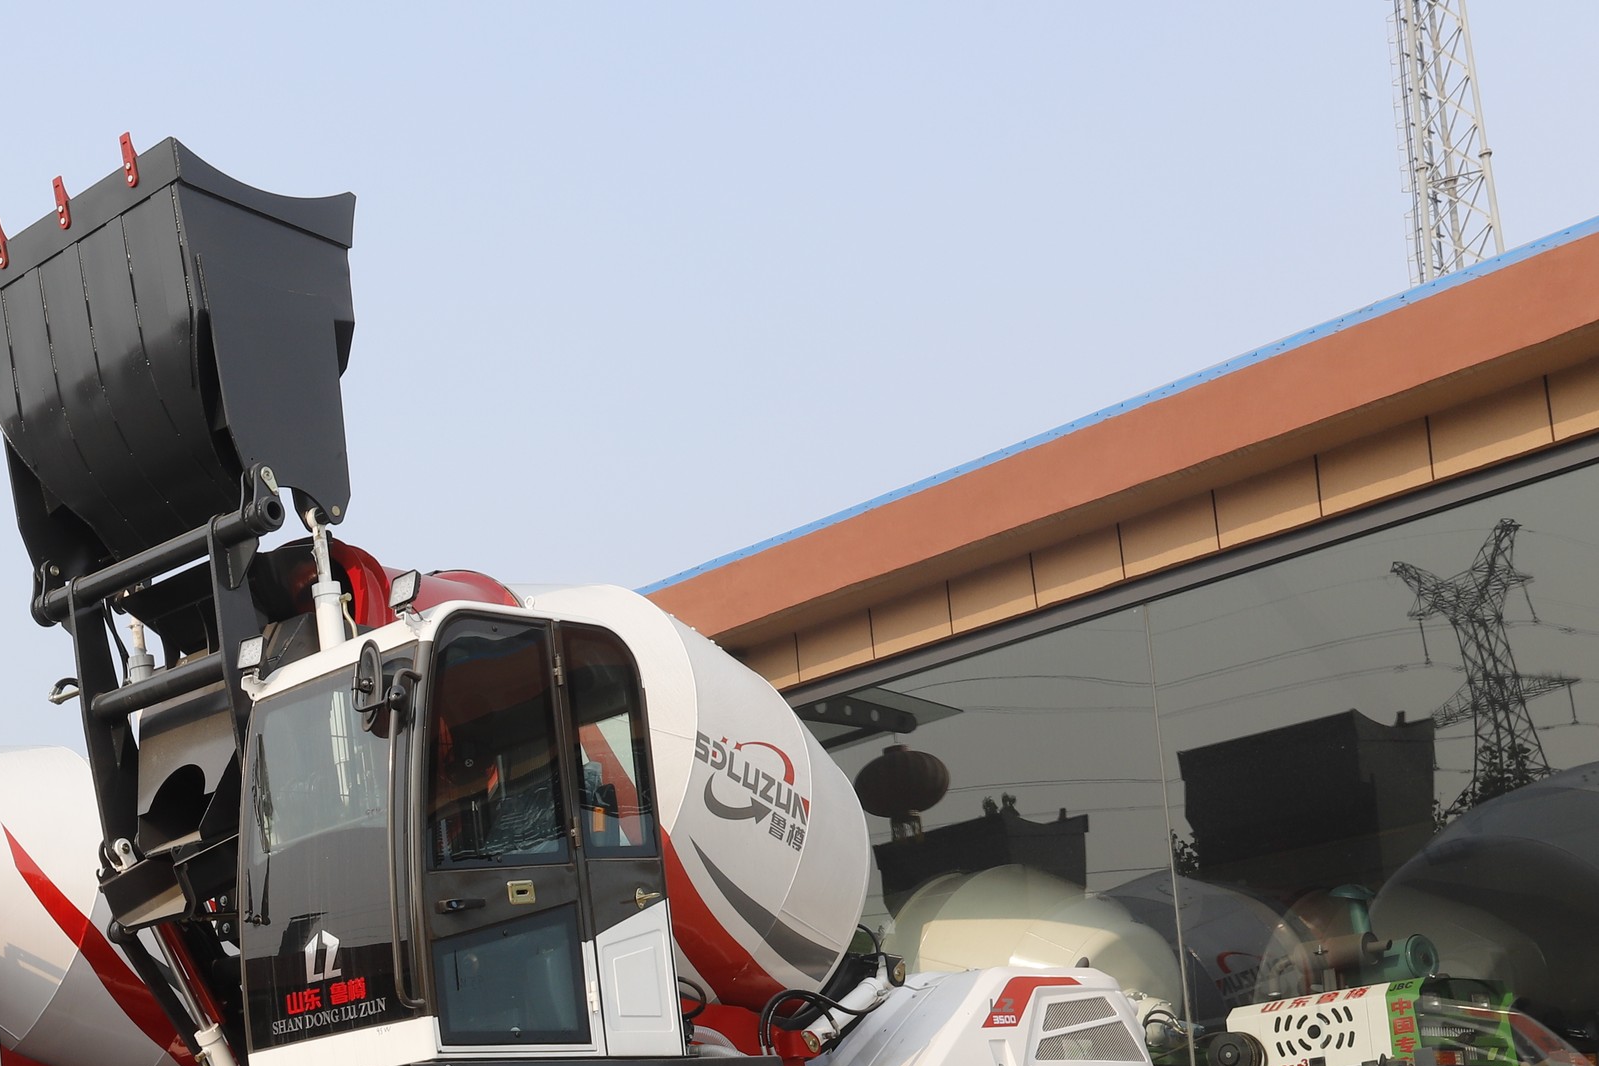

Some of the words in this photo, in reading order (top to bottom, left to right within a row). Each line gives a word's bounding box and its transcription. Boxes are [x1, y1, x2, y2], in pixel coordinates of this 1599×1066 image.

[286, 988, 321, 1015] 山东
[330, 977, 366, 1005] 鲁樽
[1389, 981, 1414, 992] JBC
[272, 1016, 303, 1035] SHAN
[305, 1009, 339, 1029] DONG
[341, 1005, 358, 1022] LU
[359, 997, 387, 1017] ZUN
[990, 998, 1014, 1012] LZ
[993, 1015, 1016, 1024] 3500
[1391, 997, 1416, 1061] 中国专
